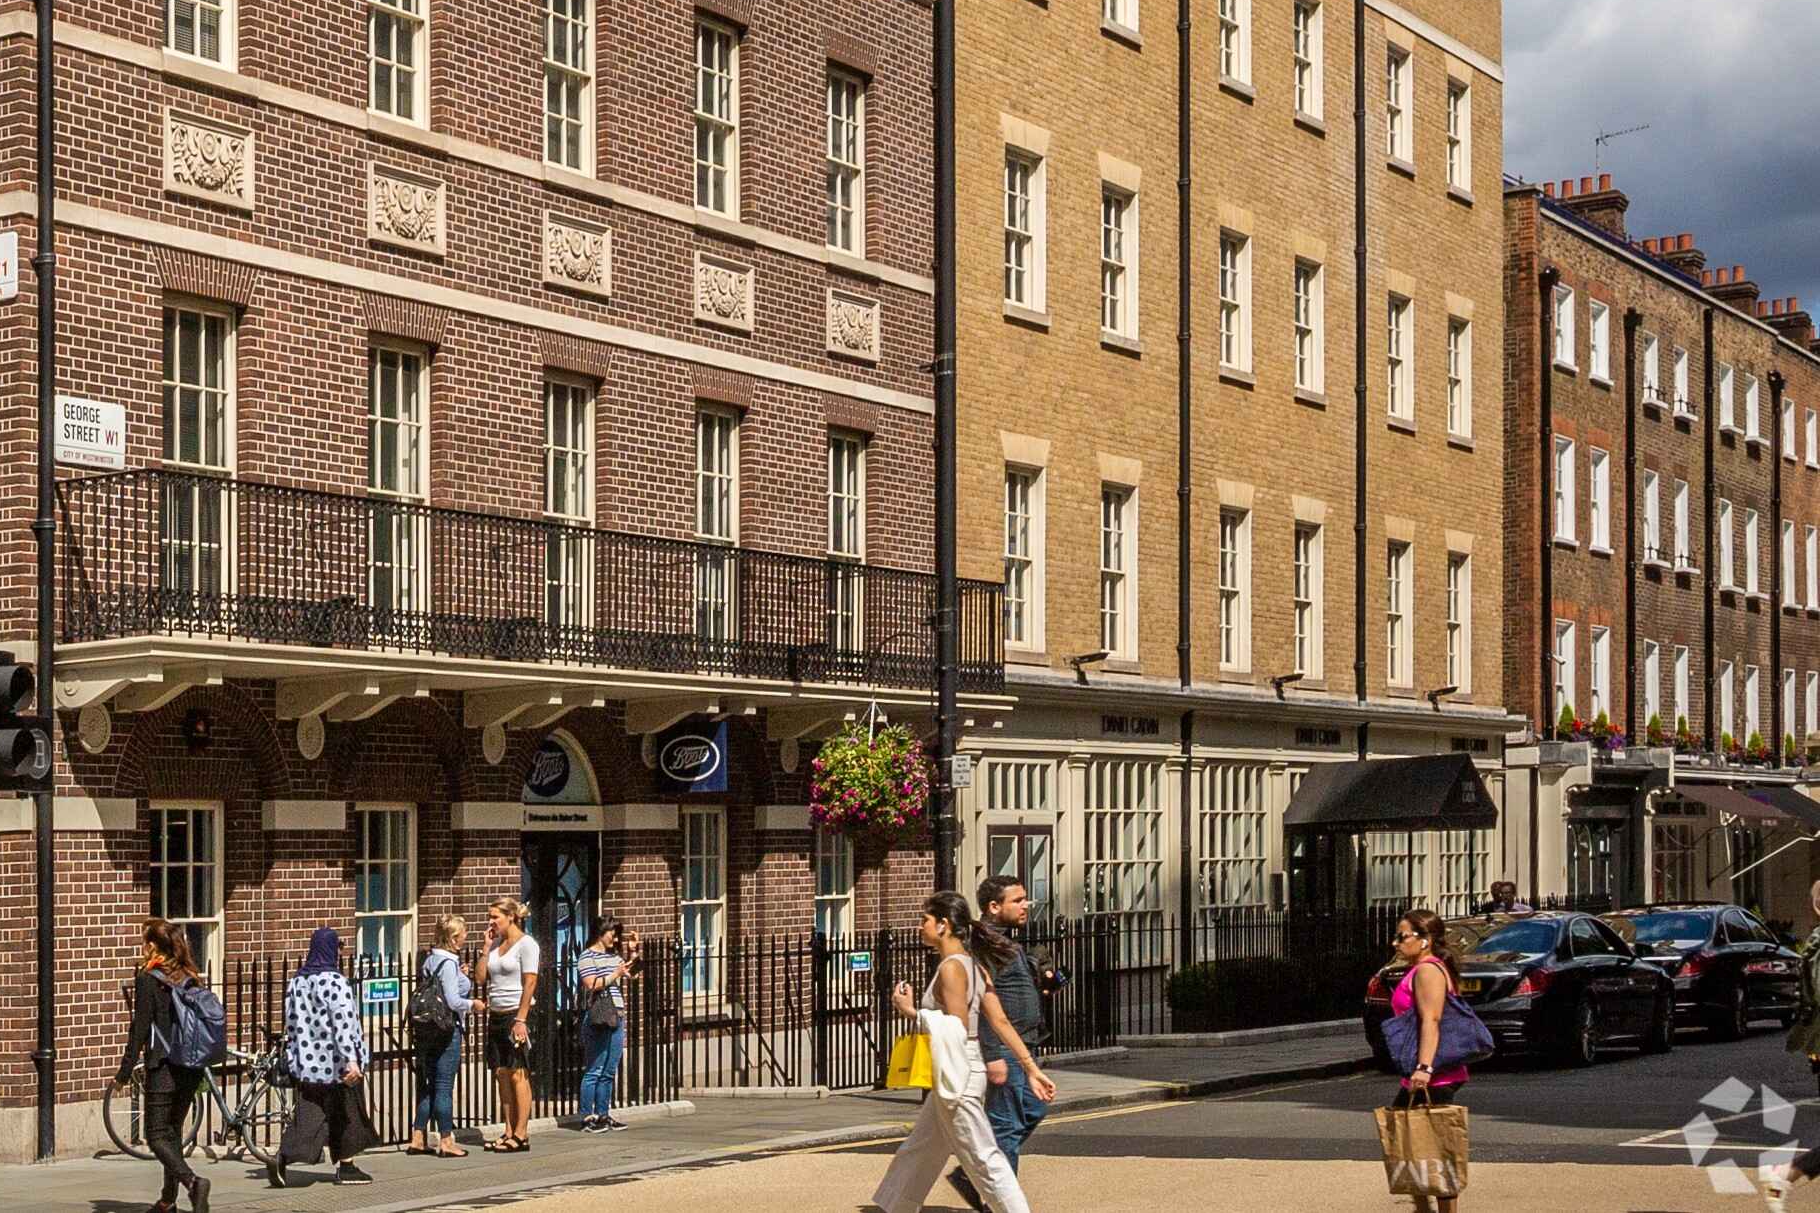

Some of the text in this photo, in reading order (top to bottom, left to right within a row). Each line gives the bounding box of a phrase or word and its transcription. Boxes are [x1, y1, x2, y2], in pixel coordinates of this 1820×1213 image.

[63, 403, 101, 424] GEORGE
[63, 423, 119, 447] STREET W1
[530, 750, 566, 786] Boots
[669, 746, 710, 770] Boots
